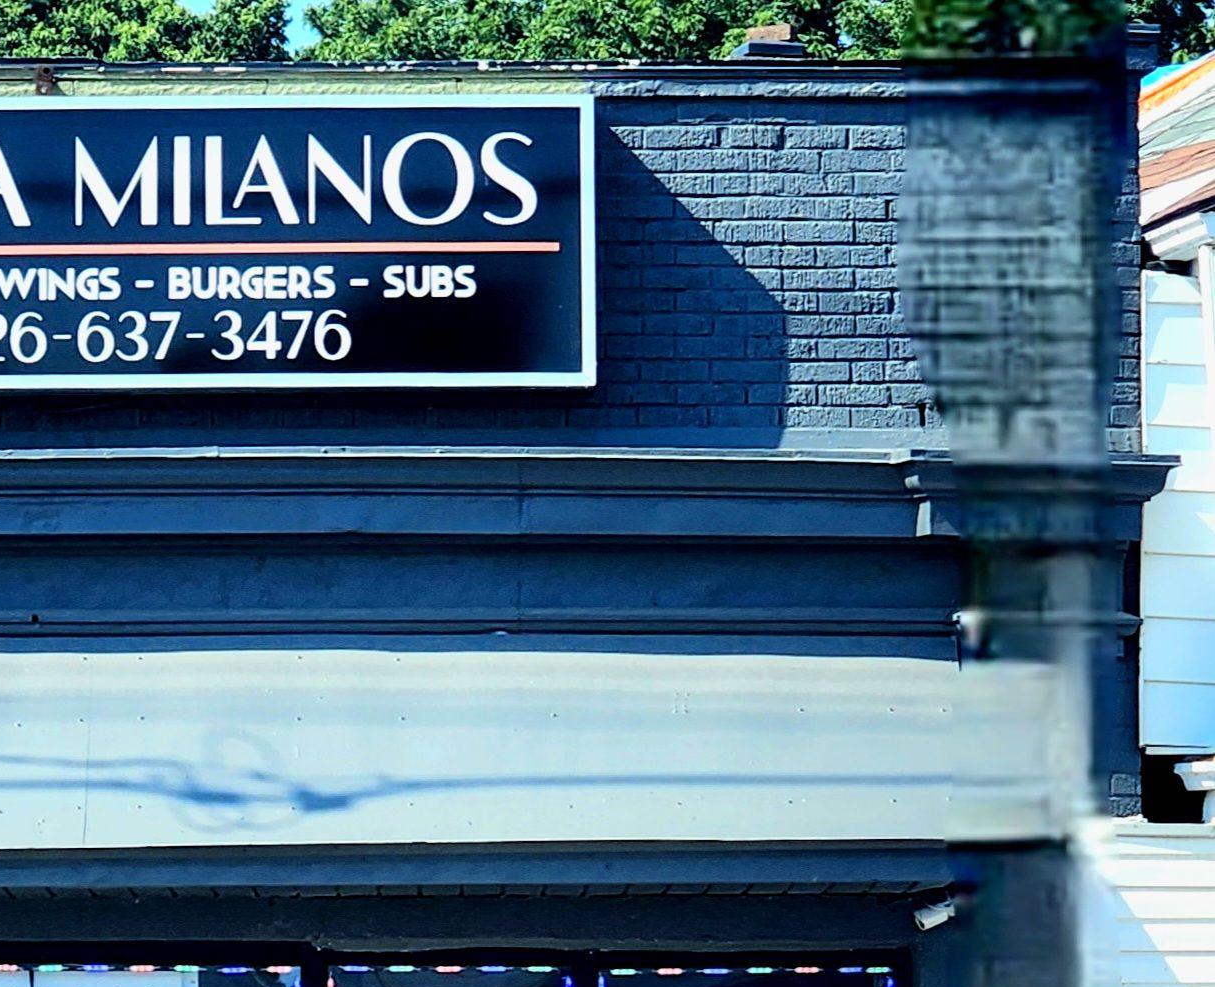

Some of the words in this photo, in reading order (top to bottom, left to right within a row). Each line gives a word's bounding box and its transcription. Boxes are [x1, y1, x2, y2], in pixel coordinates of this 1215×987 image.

[74, 131, 539, 227] MILANOS
[167, 265, 337, 301] BURGERS
[382, 264, 478, 300] SUBS
